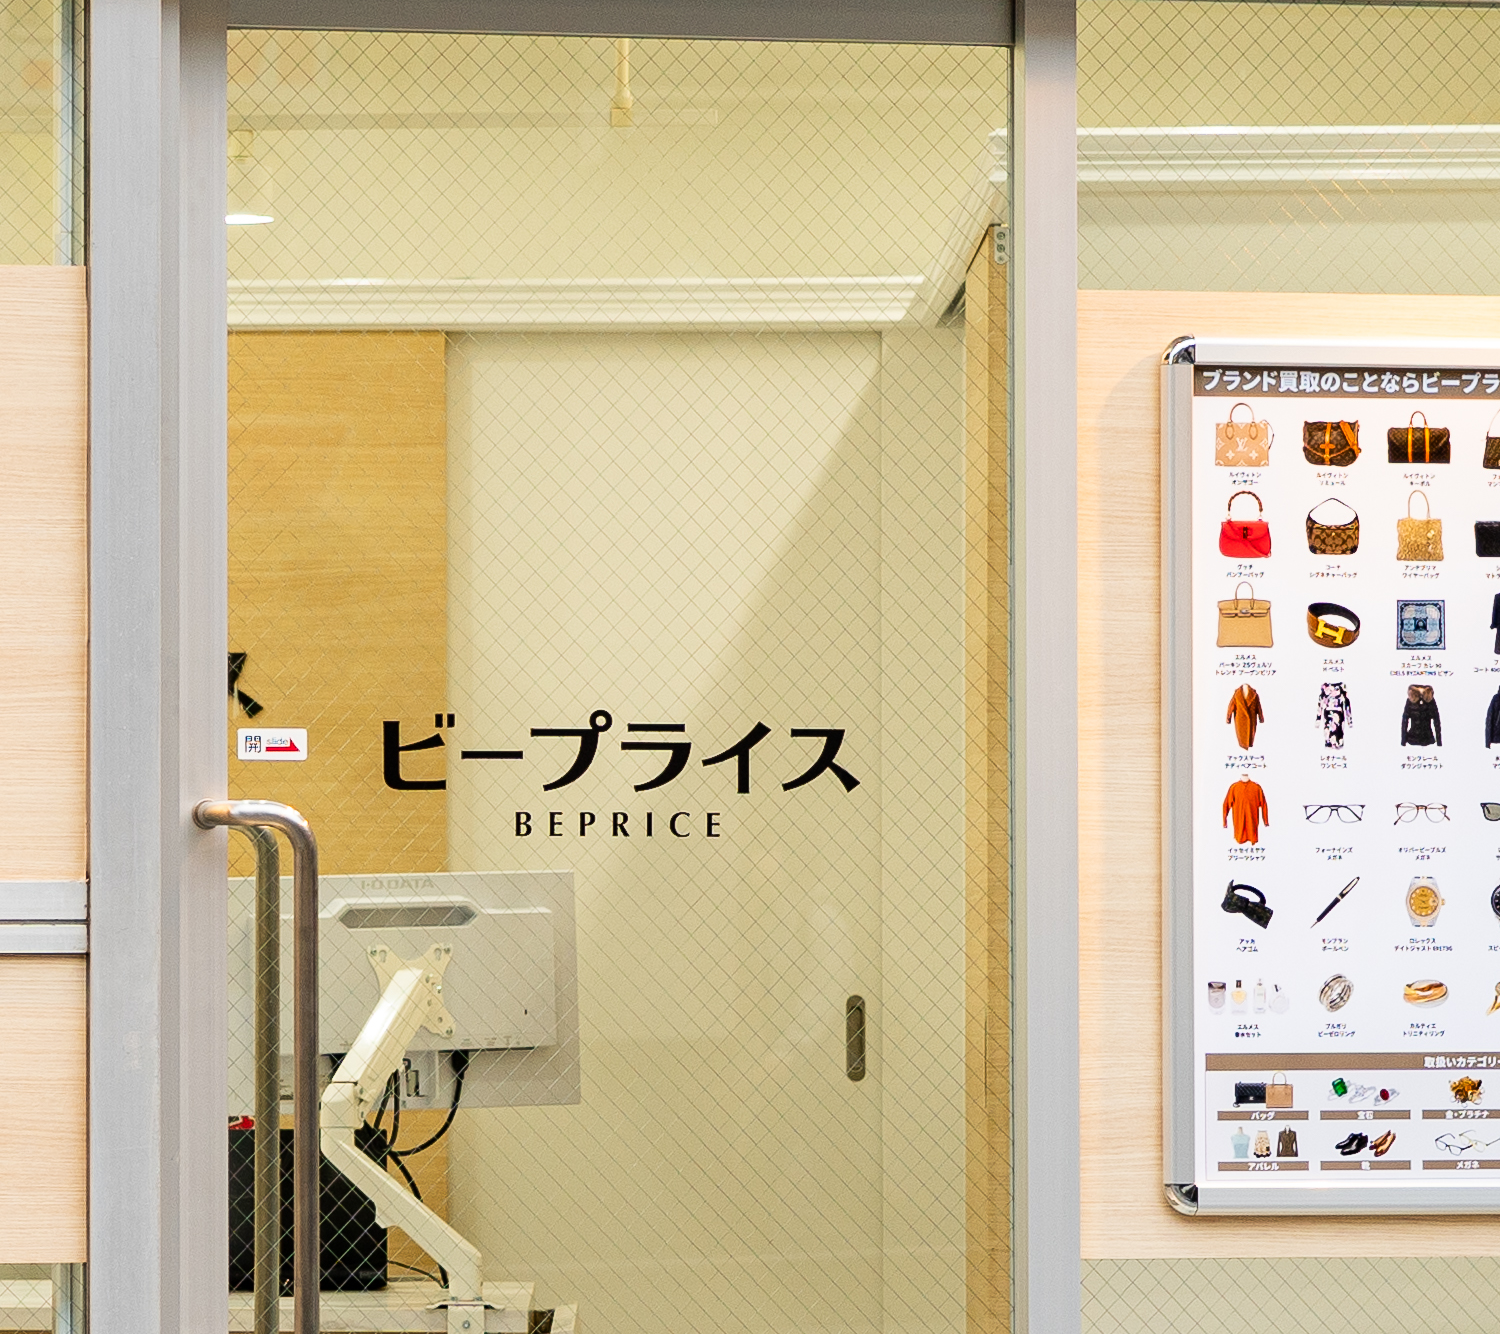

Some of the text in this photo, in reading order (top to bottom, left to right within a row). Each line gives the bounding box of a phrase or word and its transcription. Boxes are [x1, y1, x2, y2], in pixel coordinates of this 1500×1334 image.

[244, 735, 262, 754] 開
[382, 708, 861, 794] ビープライス
[514, 810, 722, 839] BEPRICE
